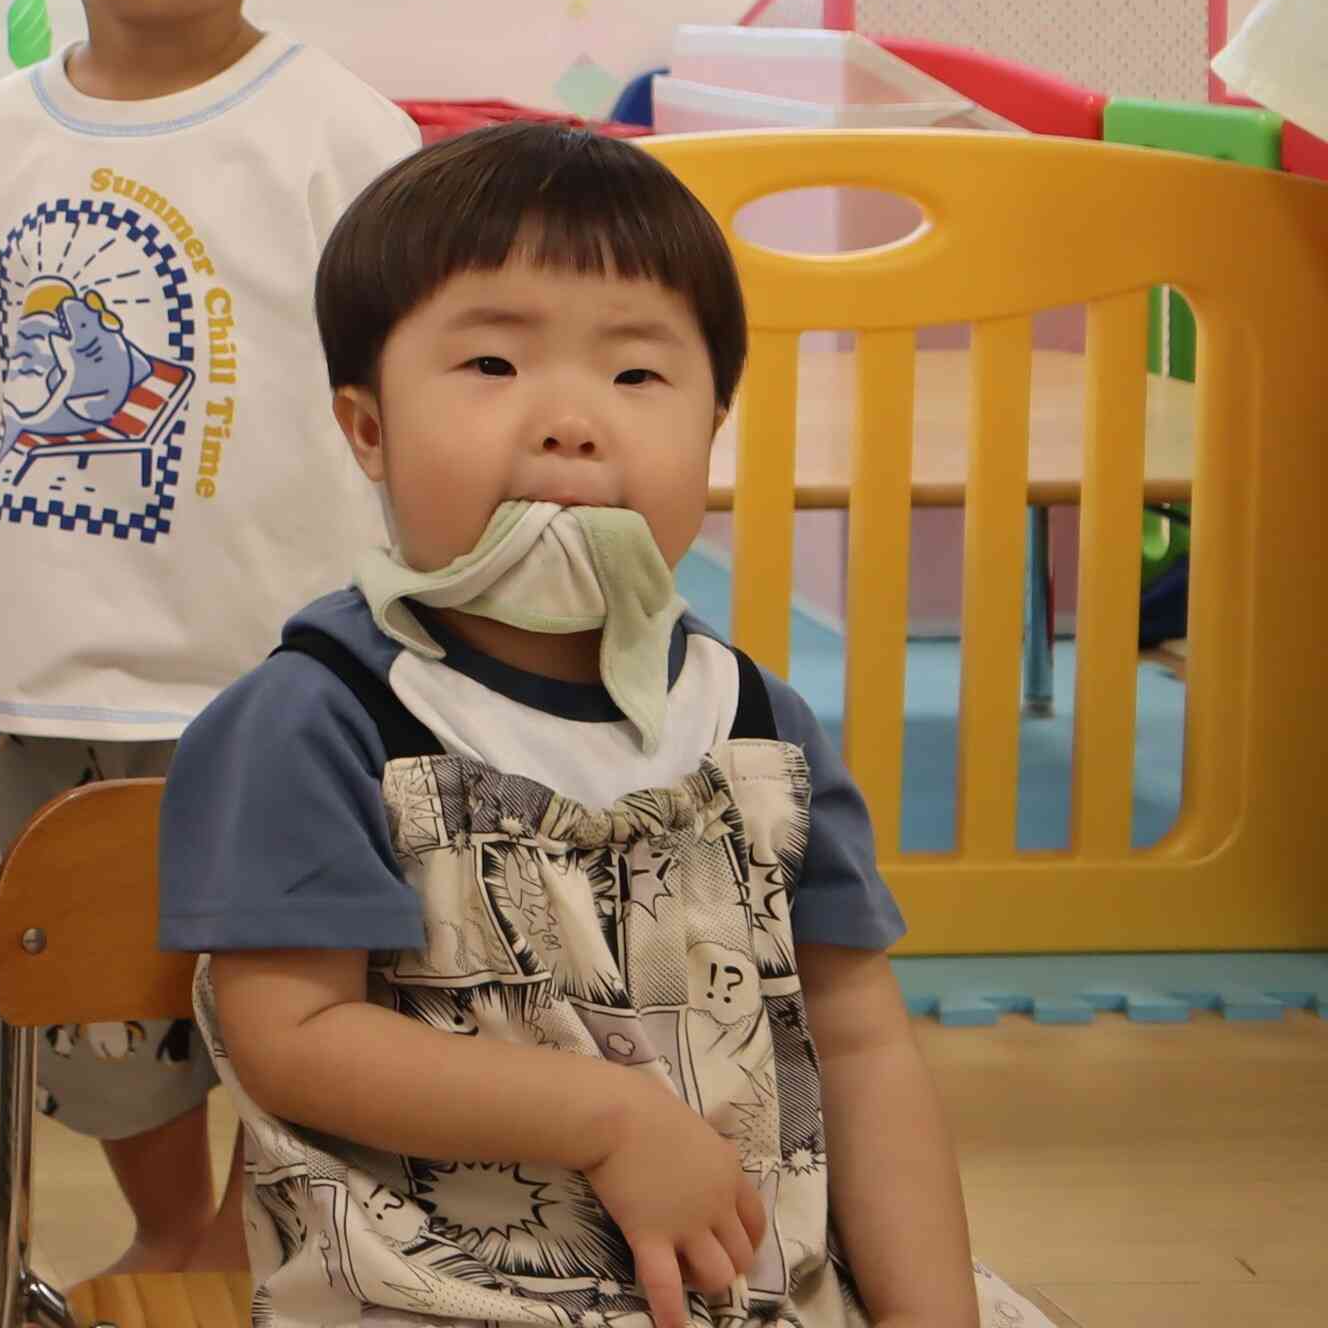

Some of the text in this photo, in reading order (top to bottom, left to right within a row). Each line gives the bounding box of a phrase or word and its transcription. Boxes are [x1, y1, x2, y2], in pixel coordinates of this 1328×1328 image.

[90, 166, 238, 499] Summer Chill Time
